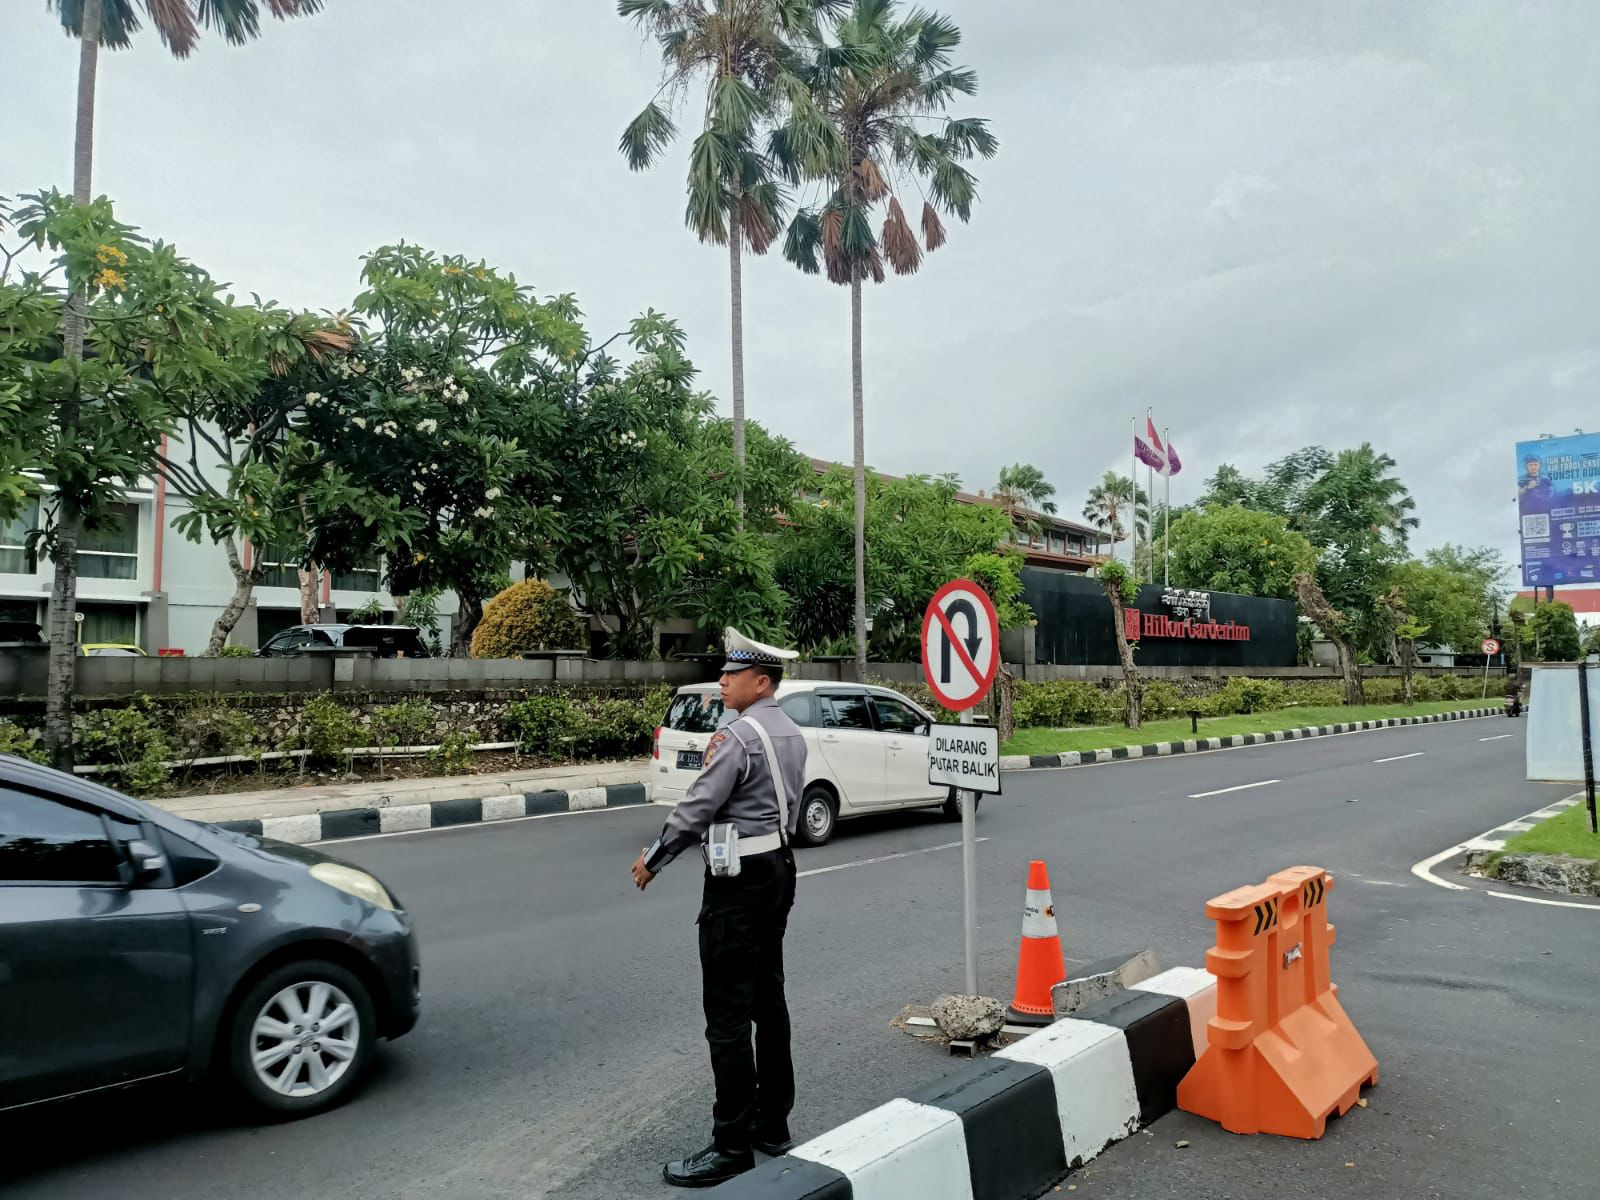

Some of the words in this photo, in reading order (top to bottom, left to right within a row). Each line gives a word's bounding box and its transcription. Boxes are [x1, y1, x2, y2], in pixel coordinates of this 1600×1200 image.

[1548, 469, 1580, 481] SUNSET
[1573, 480, 1598, 494] 5K
[1143, 614, 1185, 638] Hilton
[1187, 617, 1230, 640] Garden
[1231, 620, 1250, 641] Inn
[936, 738, 987, 755] DILARANG
[930, 756, 959, 773] PUTAR
[962, 760, 998, 778] BALIK
